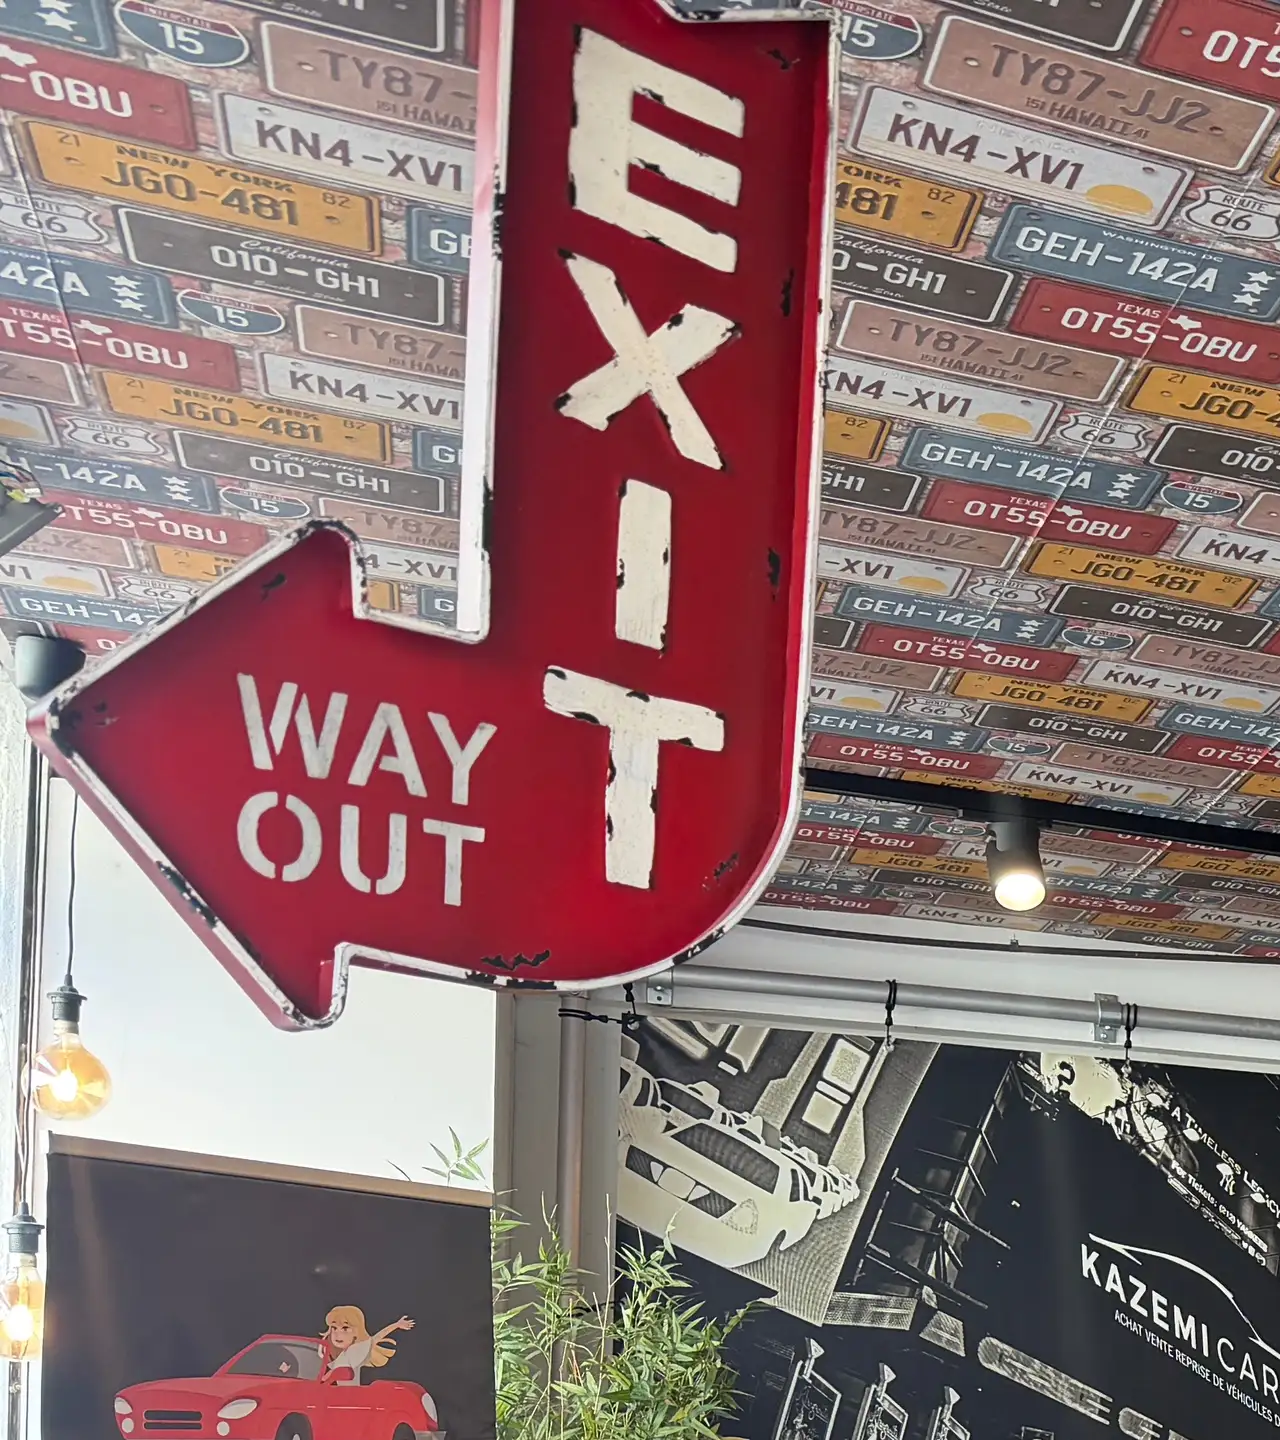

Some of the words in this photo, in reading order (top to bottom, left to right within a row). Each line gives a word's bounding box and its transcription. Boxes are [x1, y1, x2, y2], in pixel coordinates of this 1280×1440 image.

[159, 24, 203, 53] 15
[991, 48, 1210, 131] TY87-JJ2
[255, 120, 462, 191] KN4-XV1
[887, 115, 1084, 188] KN4-XV1
[1210, 209, 1252, 231] 66
[1015, 227, 1217, 291] GEH-142A
[288, 370, 459, 419] KN4-XV1
[543, 25, 745, 890] EXIT
[237, 673, 497, 805] WAY
[237, 791, 485, 907] OUT
[1114, 1309, 1143, 1337] ACHAT
[1145, 1328, 1174, 1358] VENTE
[1175, 1348, 1211, 1380] REPRISE
[1212, 1373, 1225, 1392] DE
[1226, 1383, 1273, 1422] VÉHICULES
